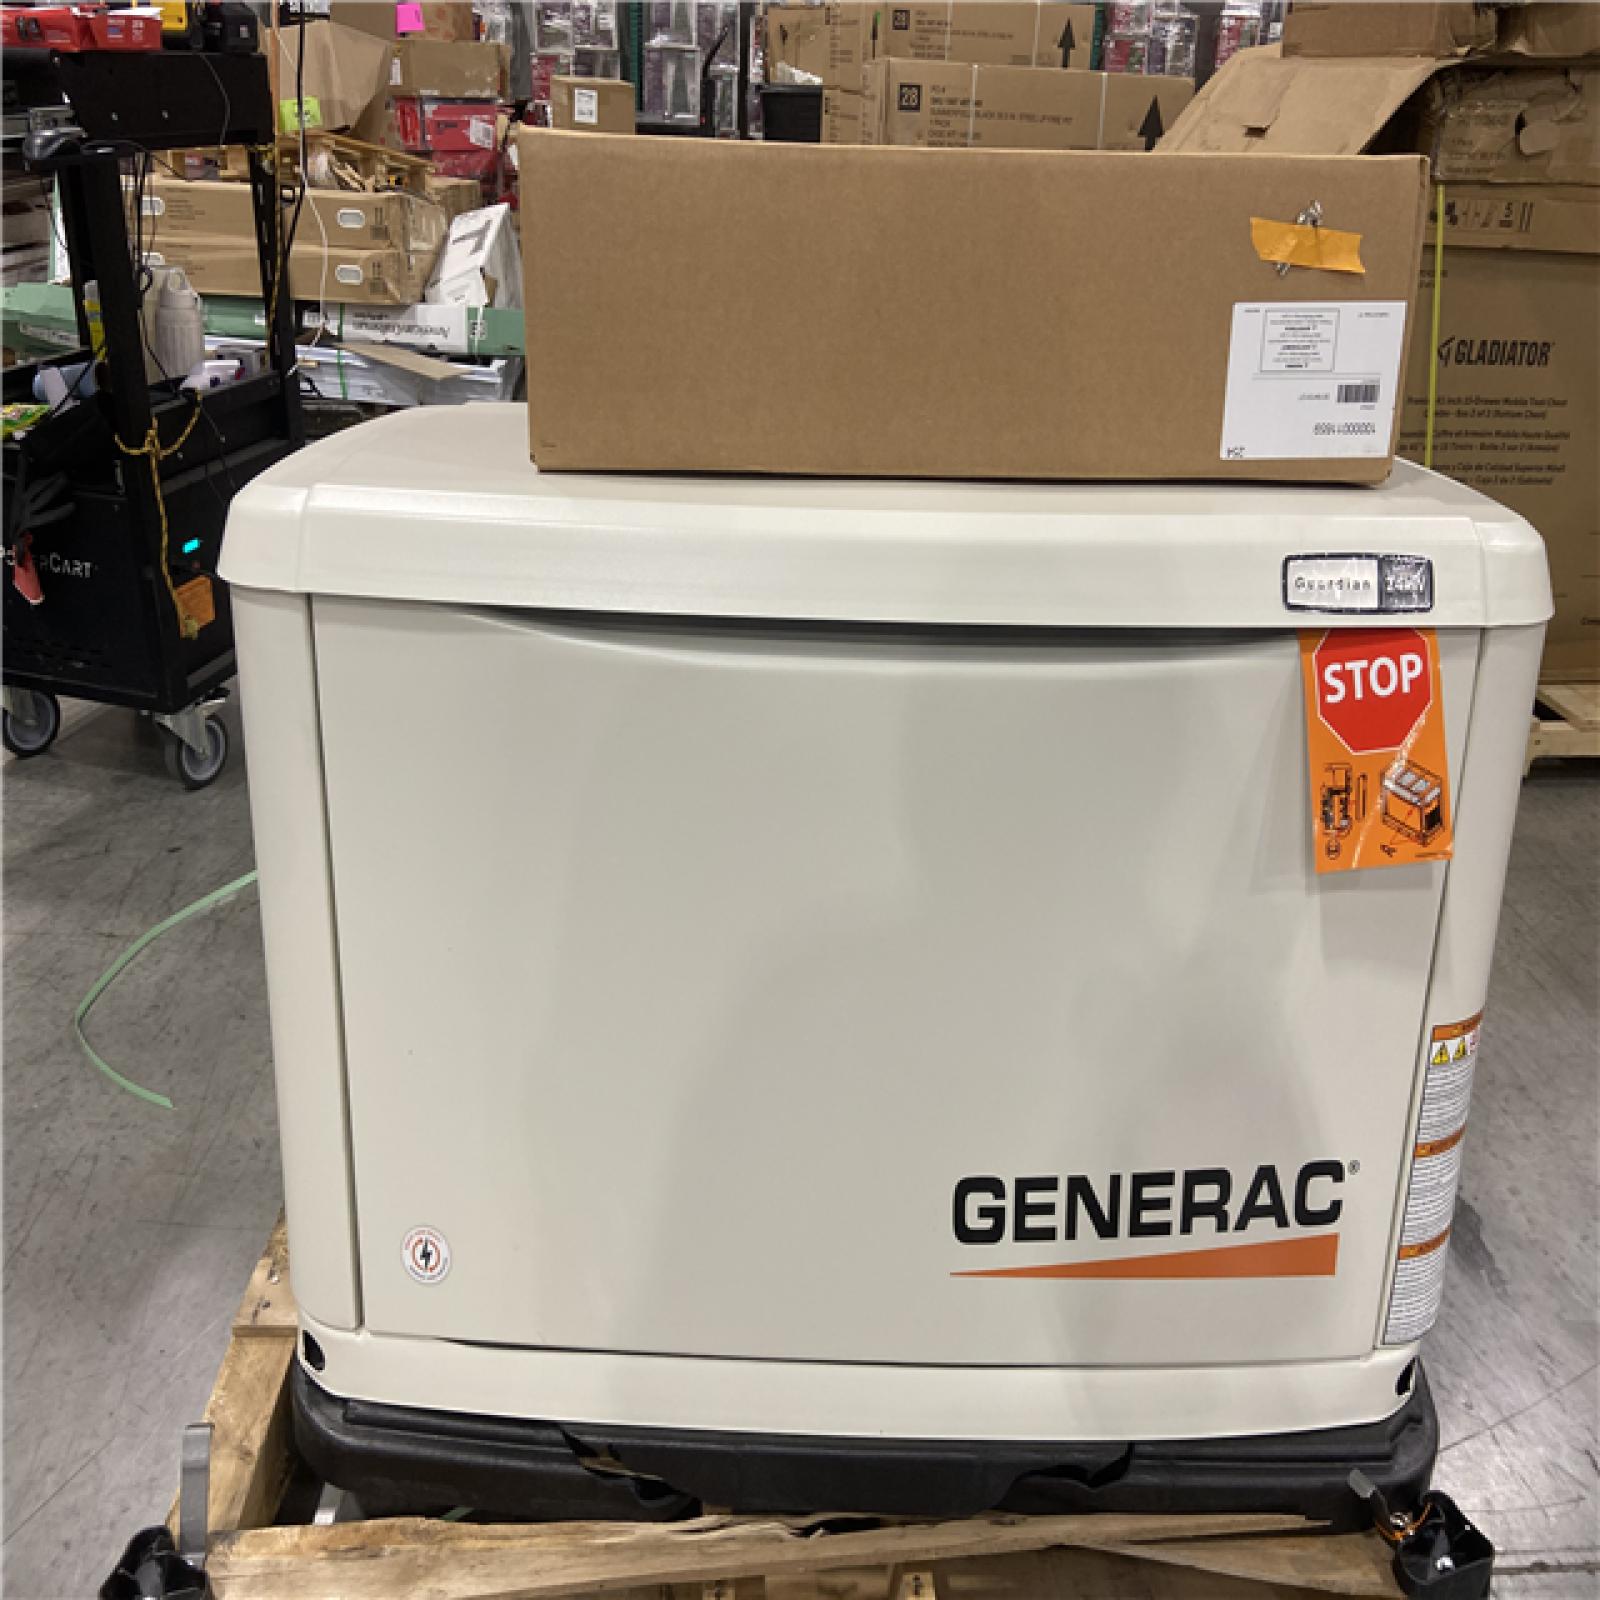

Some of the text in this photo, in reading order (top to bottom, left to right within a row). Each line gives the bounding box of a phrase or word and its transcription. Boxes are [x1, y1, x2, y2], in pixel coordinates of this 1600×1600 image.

[1453, 339, 1551, 367] GLADIATOR
[1323, 652, 1424, 704] STOP
[952, 1159, 1346, 1244] GENERAC
